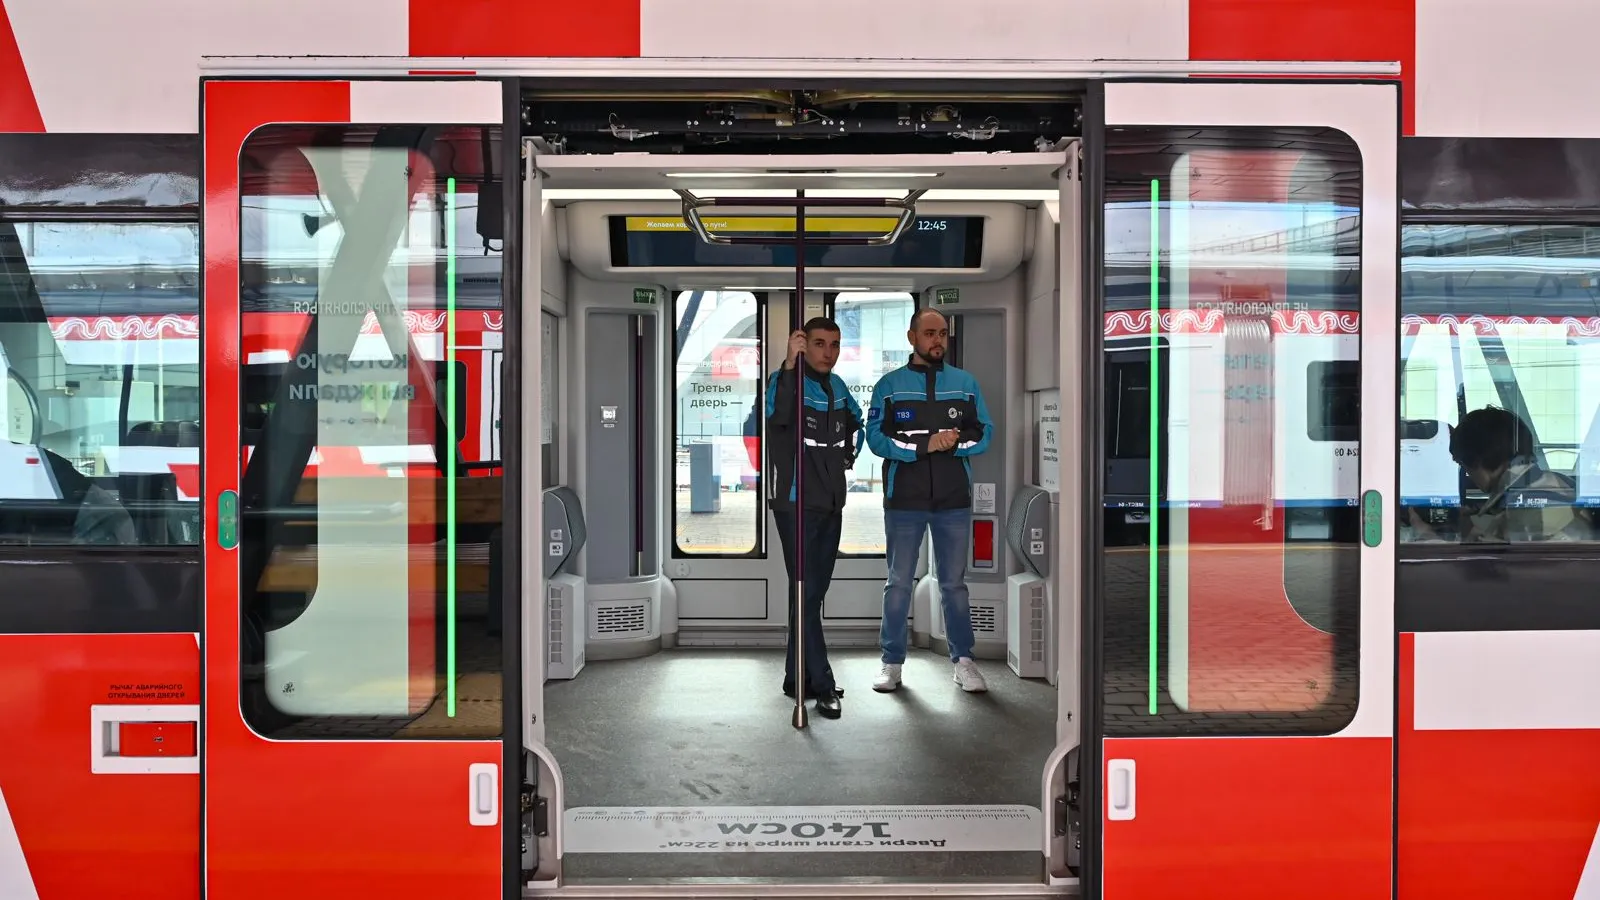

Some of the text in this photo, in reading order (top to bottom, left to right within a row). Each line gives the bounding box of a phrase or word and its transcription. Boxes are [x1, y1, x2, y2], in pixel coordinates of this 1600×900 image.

[710, 221, 727, 229] пути!
[918, 220, 947, 230] 12:45
[690, 383, 732, 394] Третья
[690, 400, 728, 409] дверь
[717, 822, 892, 838] 140см
[879, 838, 947, 848] Двери
